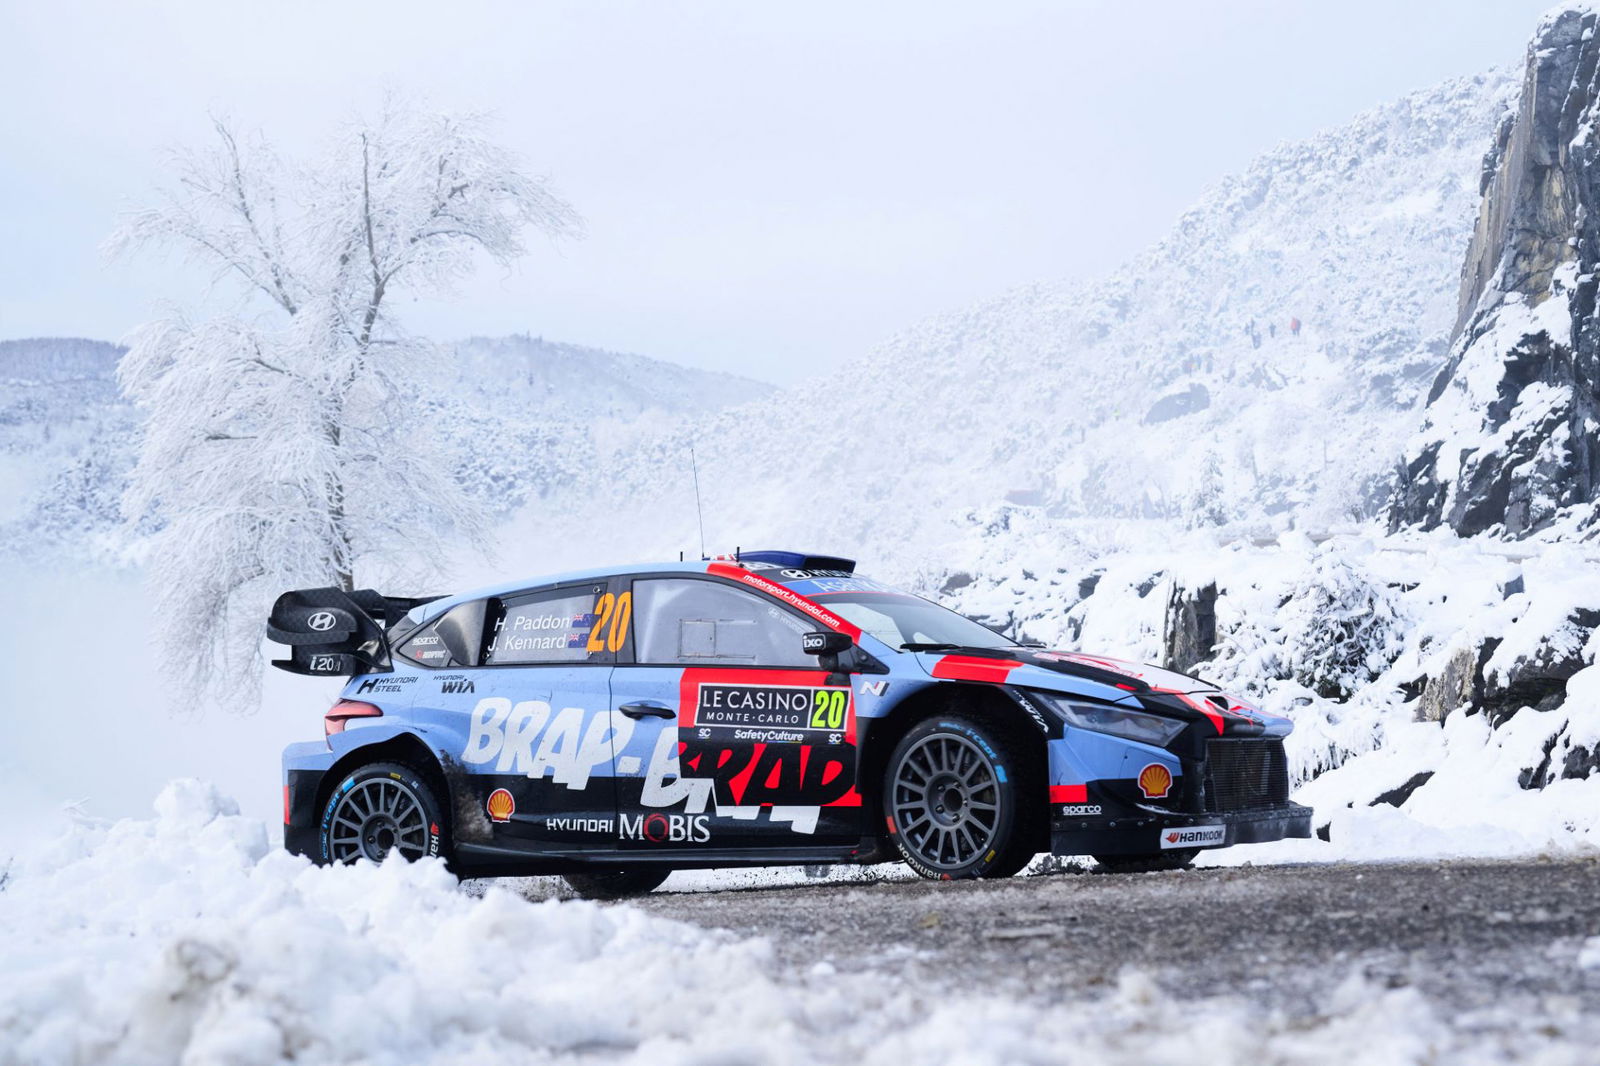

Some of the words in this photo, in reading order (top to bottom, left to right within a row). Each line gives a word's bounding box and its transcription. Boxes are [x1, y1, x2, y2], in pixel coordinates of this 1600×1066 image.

[743, 574, 840, 627] motorsport.hyundai.com
[494, 617, 509, 632] H.
[513, 615, 570, 632] Paddon
[586, 591, 632, 653] 20
[487, 635, 499, 652] J.
[504, 633, 567, 651] Kennard
[379, 676, 419, 684] HYUNDAI
[374, 685, 402, 693] STEEL
[702, 690, 723, 708] LE
[727, 691, 808, 711] CASINO
[811, 690, 845, 729] 20
[698, 728, 711, 738] SC
[734, 729, 804, 742] SafetyCulture
[828, 733, 842, 743] SC
[1062, 804, 1102, 816] sparco
[546, 818, 613, 833] HYUNDAI
[619, 813, 711, 843] MOBIS
